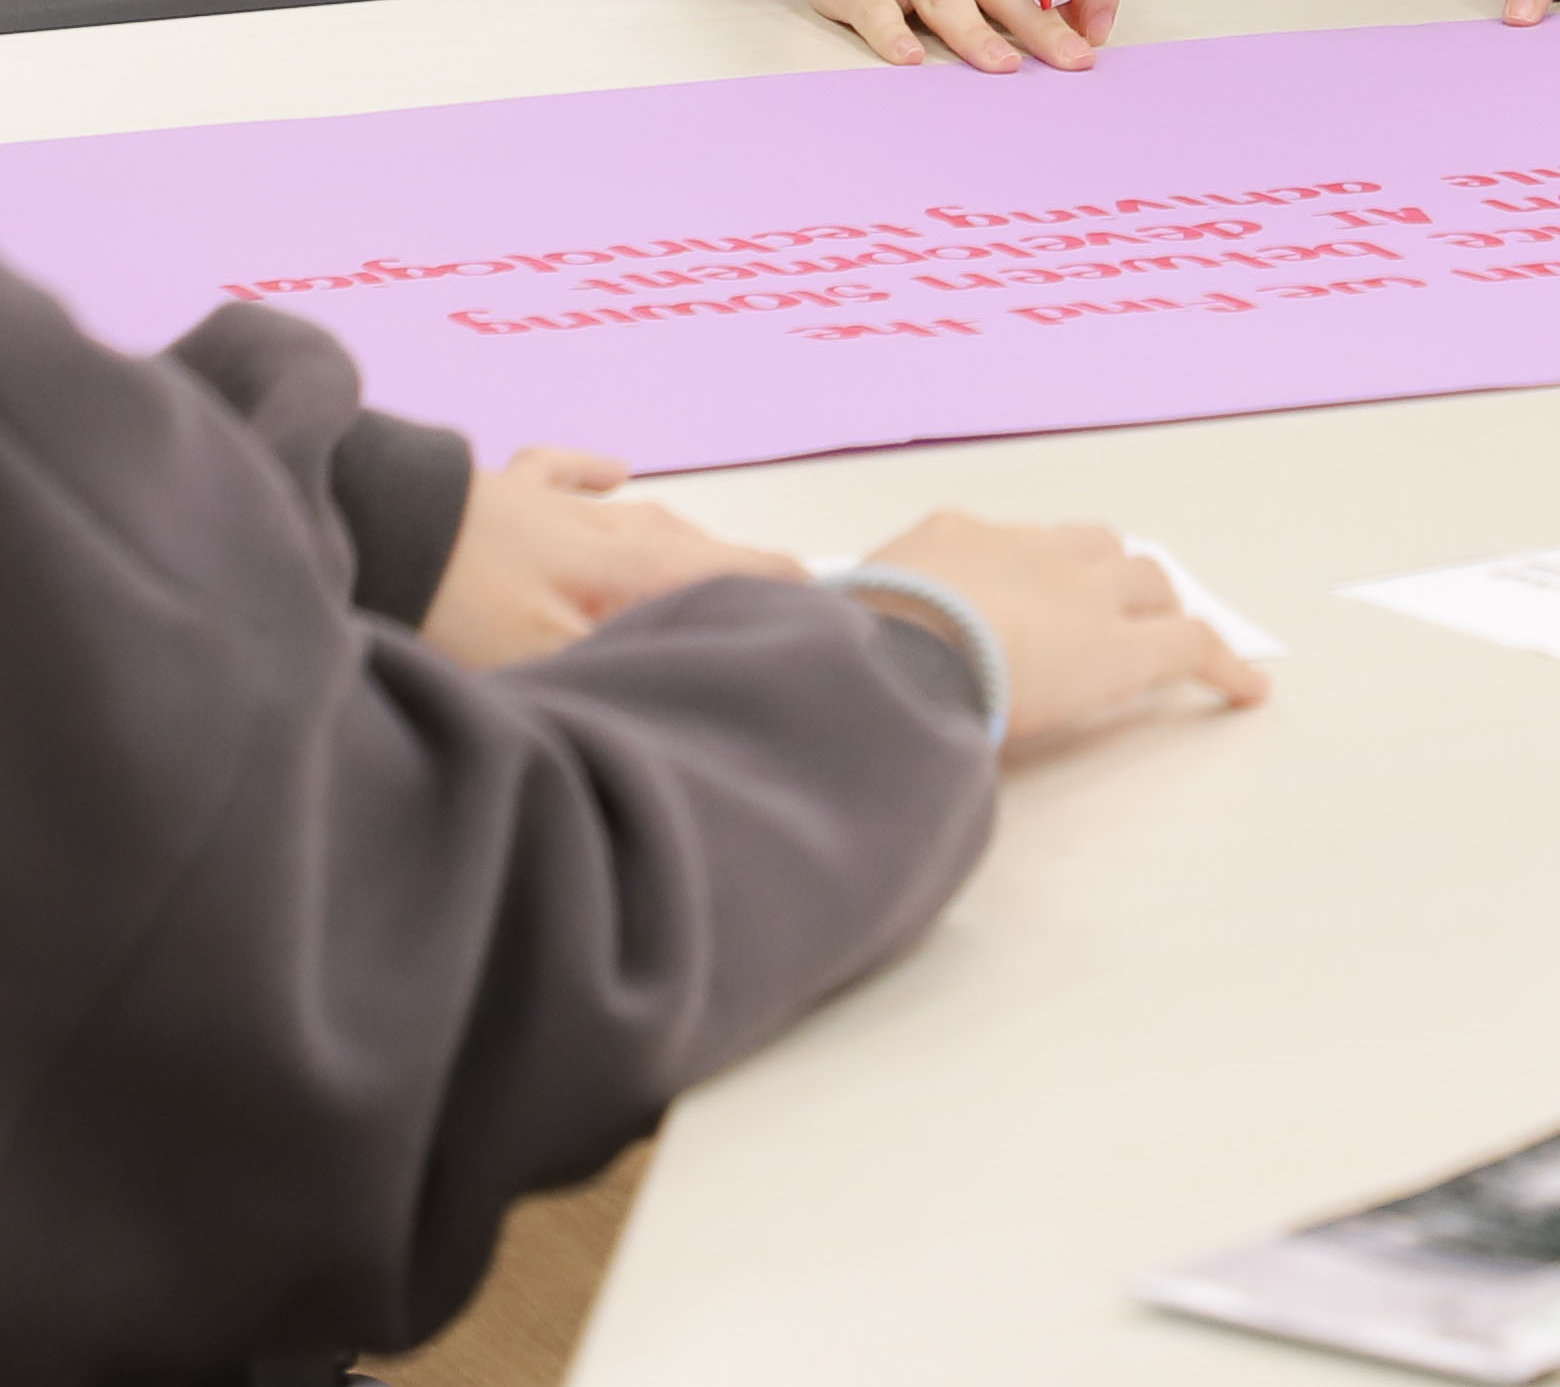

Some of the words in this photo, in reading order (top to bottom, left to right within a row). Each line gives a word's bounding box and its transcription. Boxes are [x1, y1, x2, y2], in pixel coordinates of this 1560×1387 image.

[924, 180, 1380, 229] achiving
[1312, 205, 1430, 229] AI
[220, 222, 920, 301] technological
[569, 219, 1261, 295] development
[908, 238, 1401, 293] between
[446, 283, 889, 336] slowing
[1257, 275, 1427, 300] we
[783, 317, 982, 340] the
